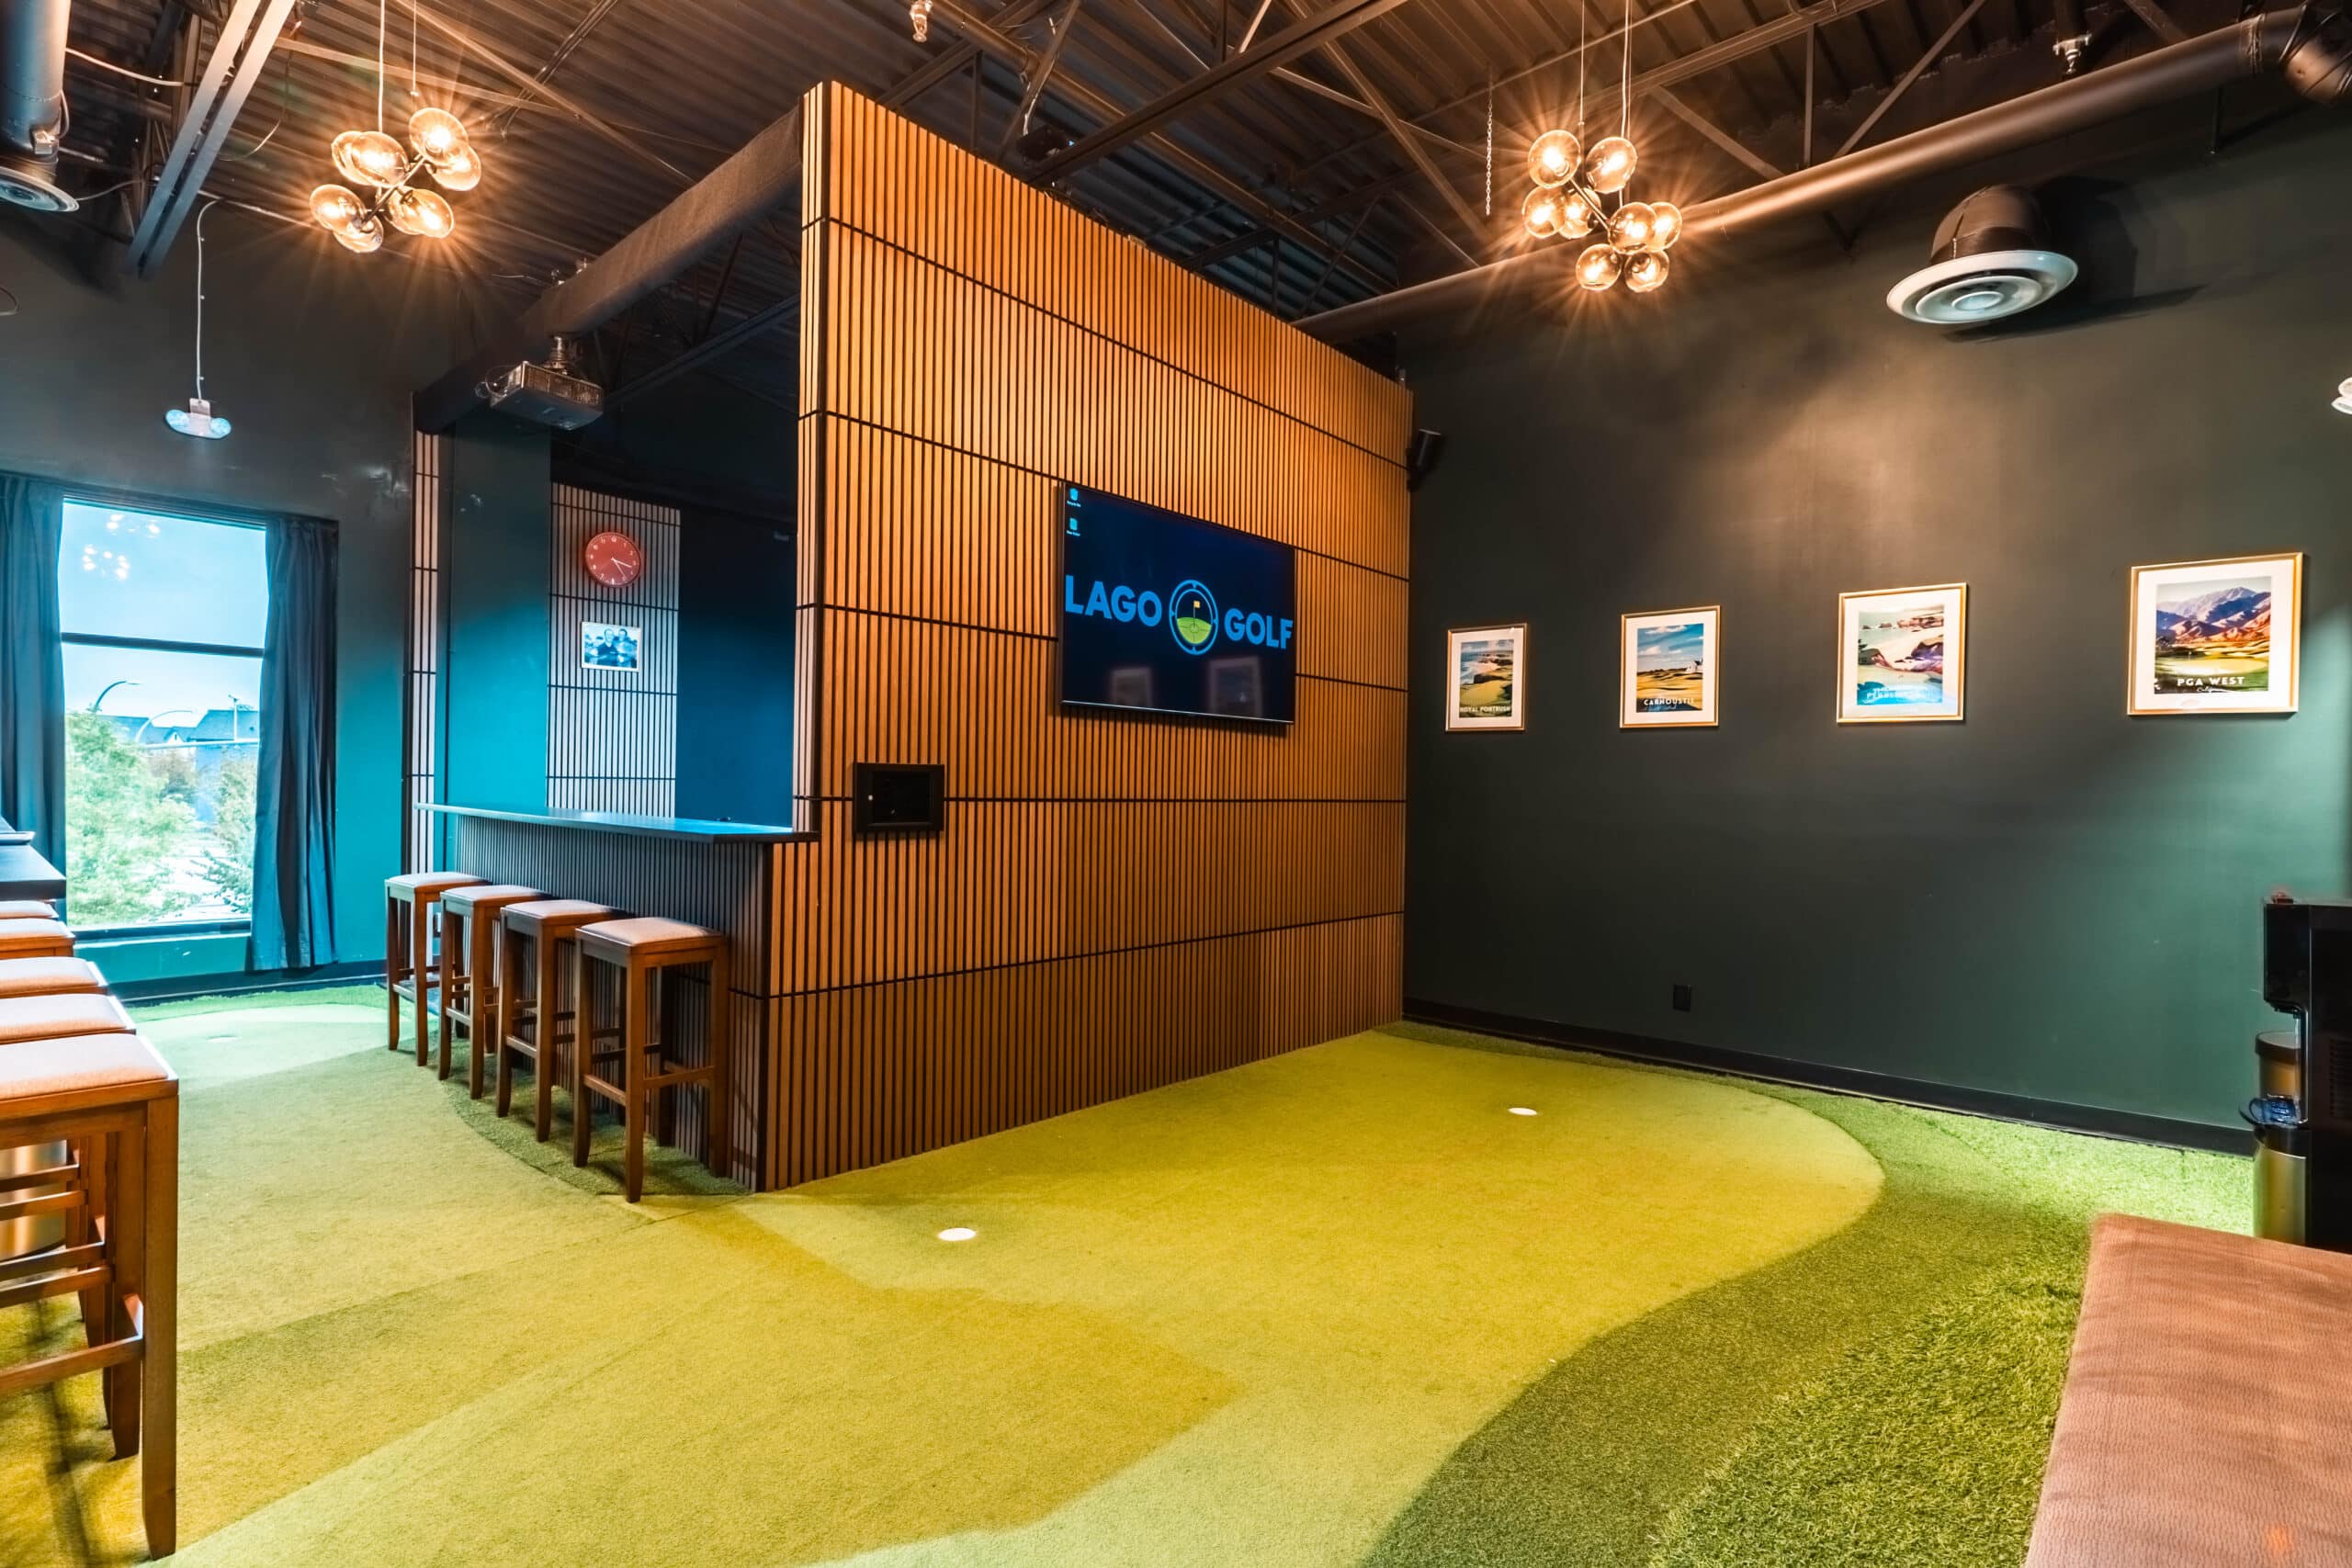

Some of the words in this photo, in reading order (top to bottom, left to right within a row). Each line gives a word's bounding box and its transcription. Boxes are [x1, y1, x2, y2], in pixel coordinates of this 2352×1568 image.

[1065, 574, 1162, 626] LAGO
[1224, 607, 1294, 649] GOLF
[2177, 677, 2203, 686] PGA
[2209, 676, 2245, 685] WEST
